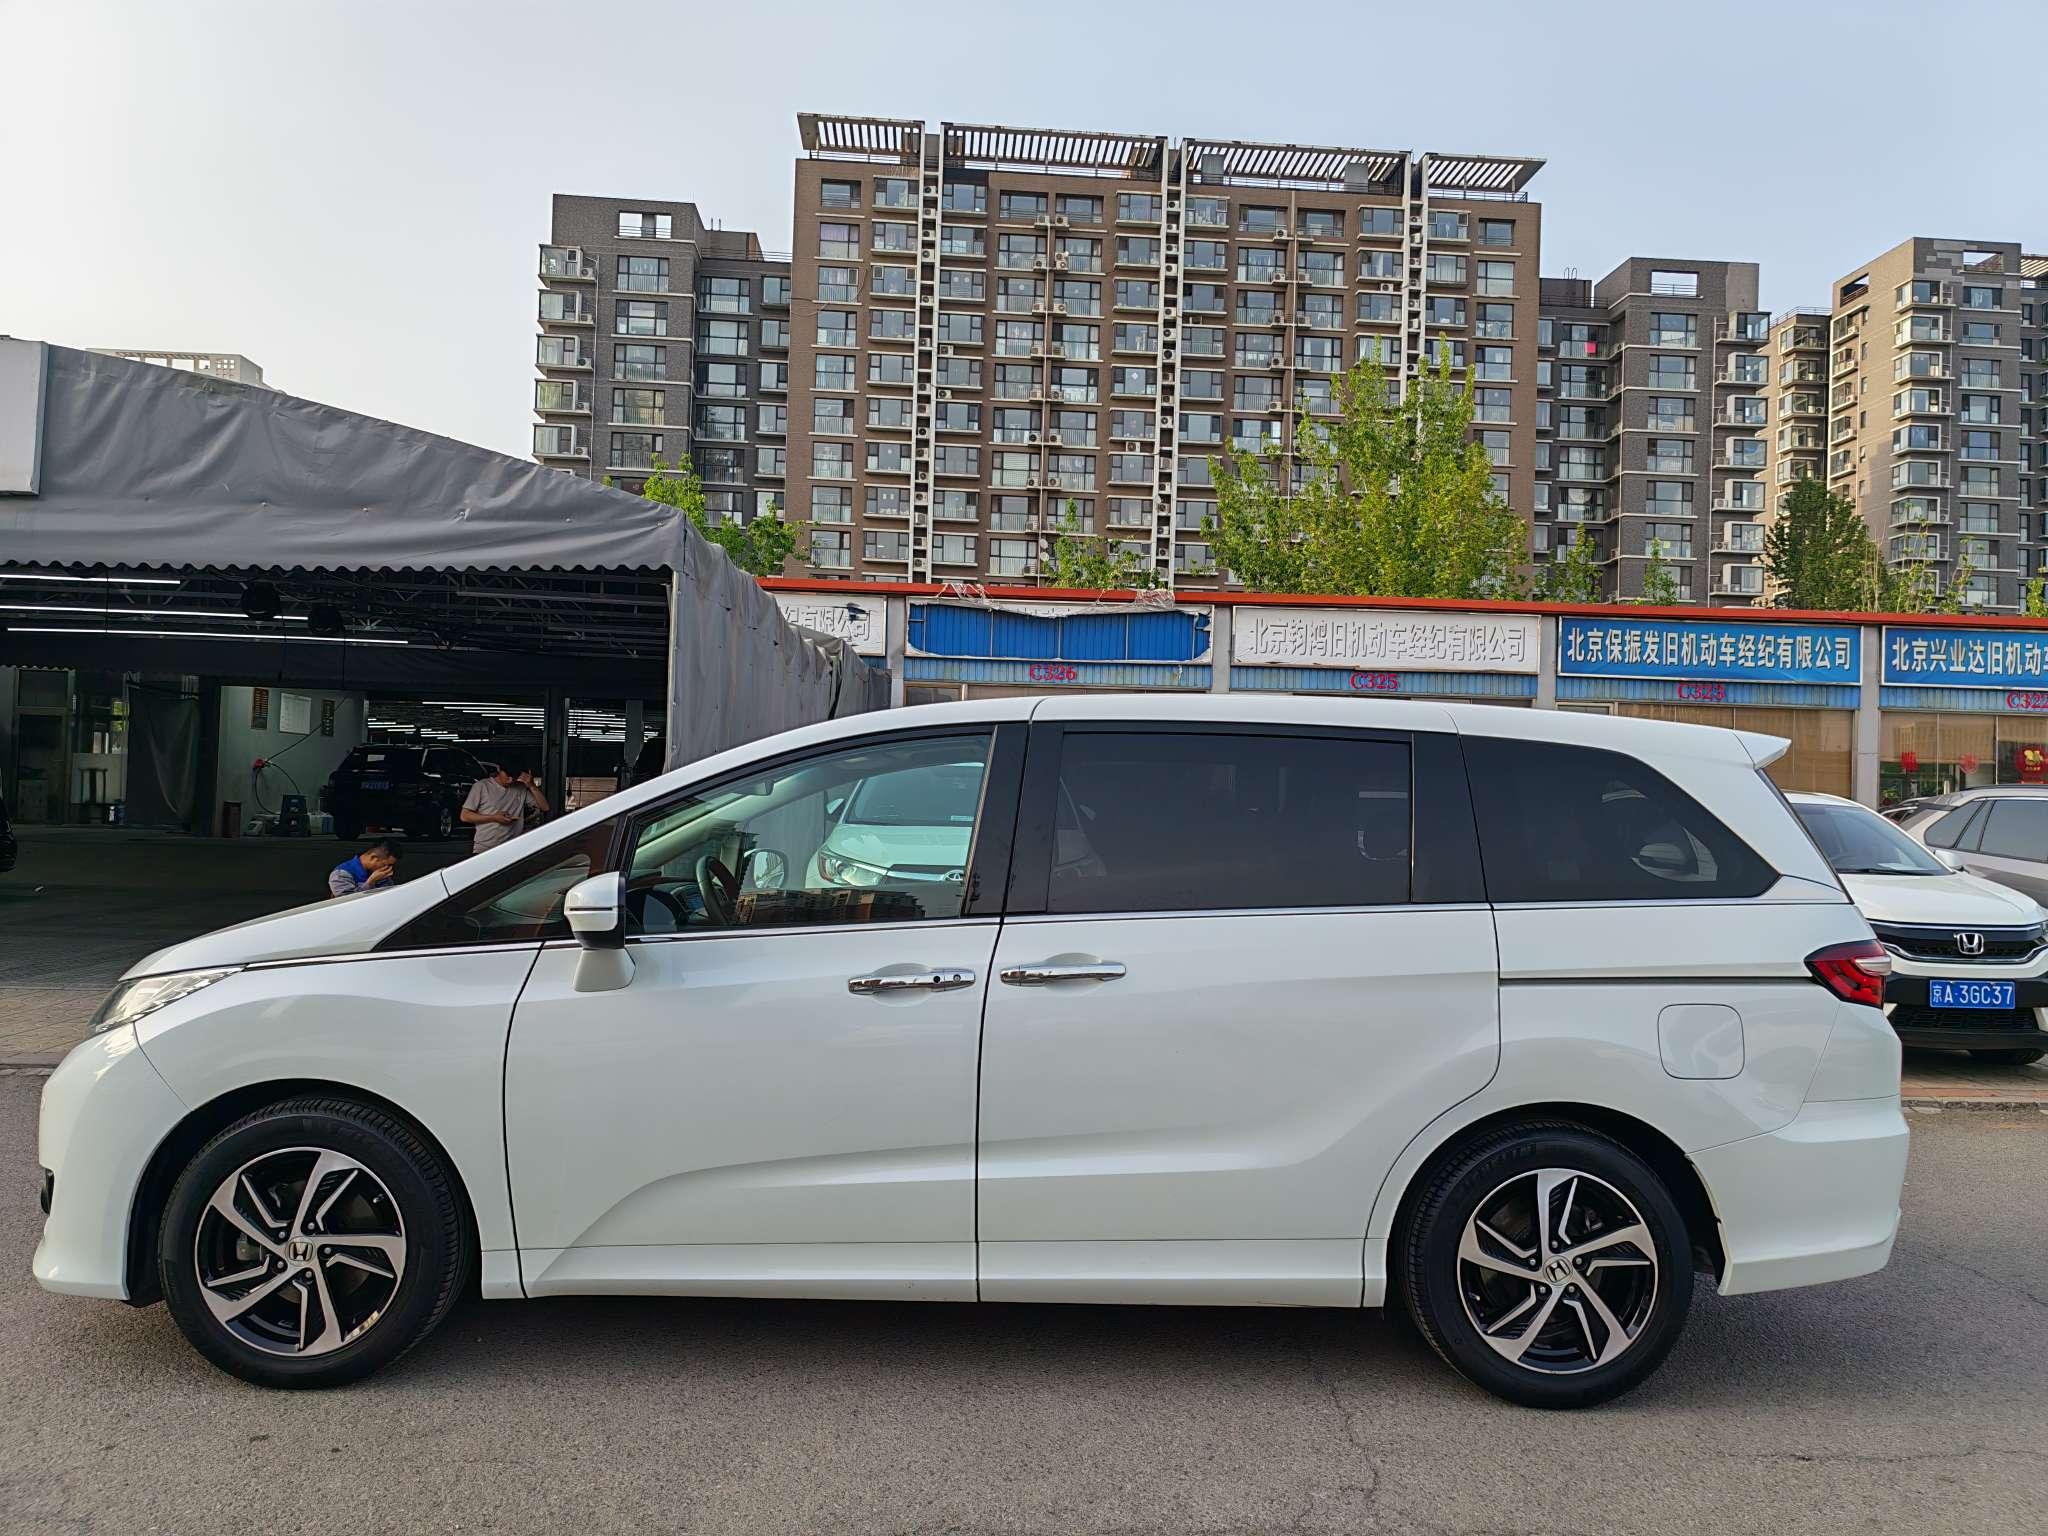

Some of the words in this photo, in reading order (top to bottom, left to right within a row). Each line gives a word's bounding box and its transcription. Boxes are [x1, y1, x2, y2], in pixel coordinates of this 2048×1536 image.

[1567, 627, 1852, 670] 北京保振发旧机动车经纪有限公司
[1891, 636, 2048, 676] 北京兴业达旧机动
[1029, 663, 1078, 681] C326
[1350, 672, 1398, 690] C325
[1677, 682, 1726, 700] C323
